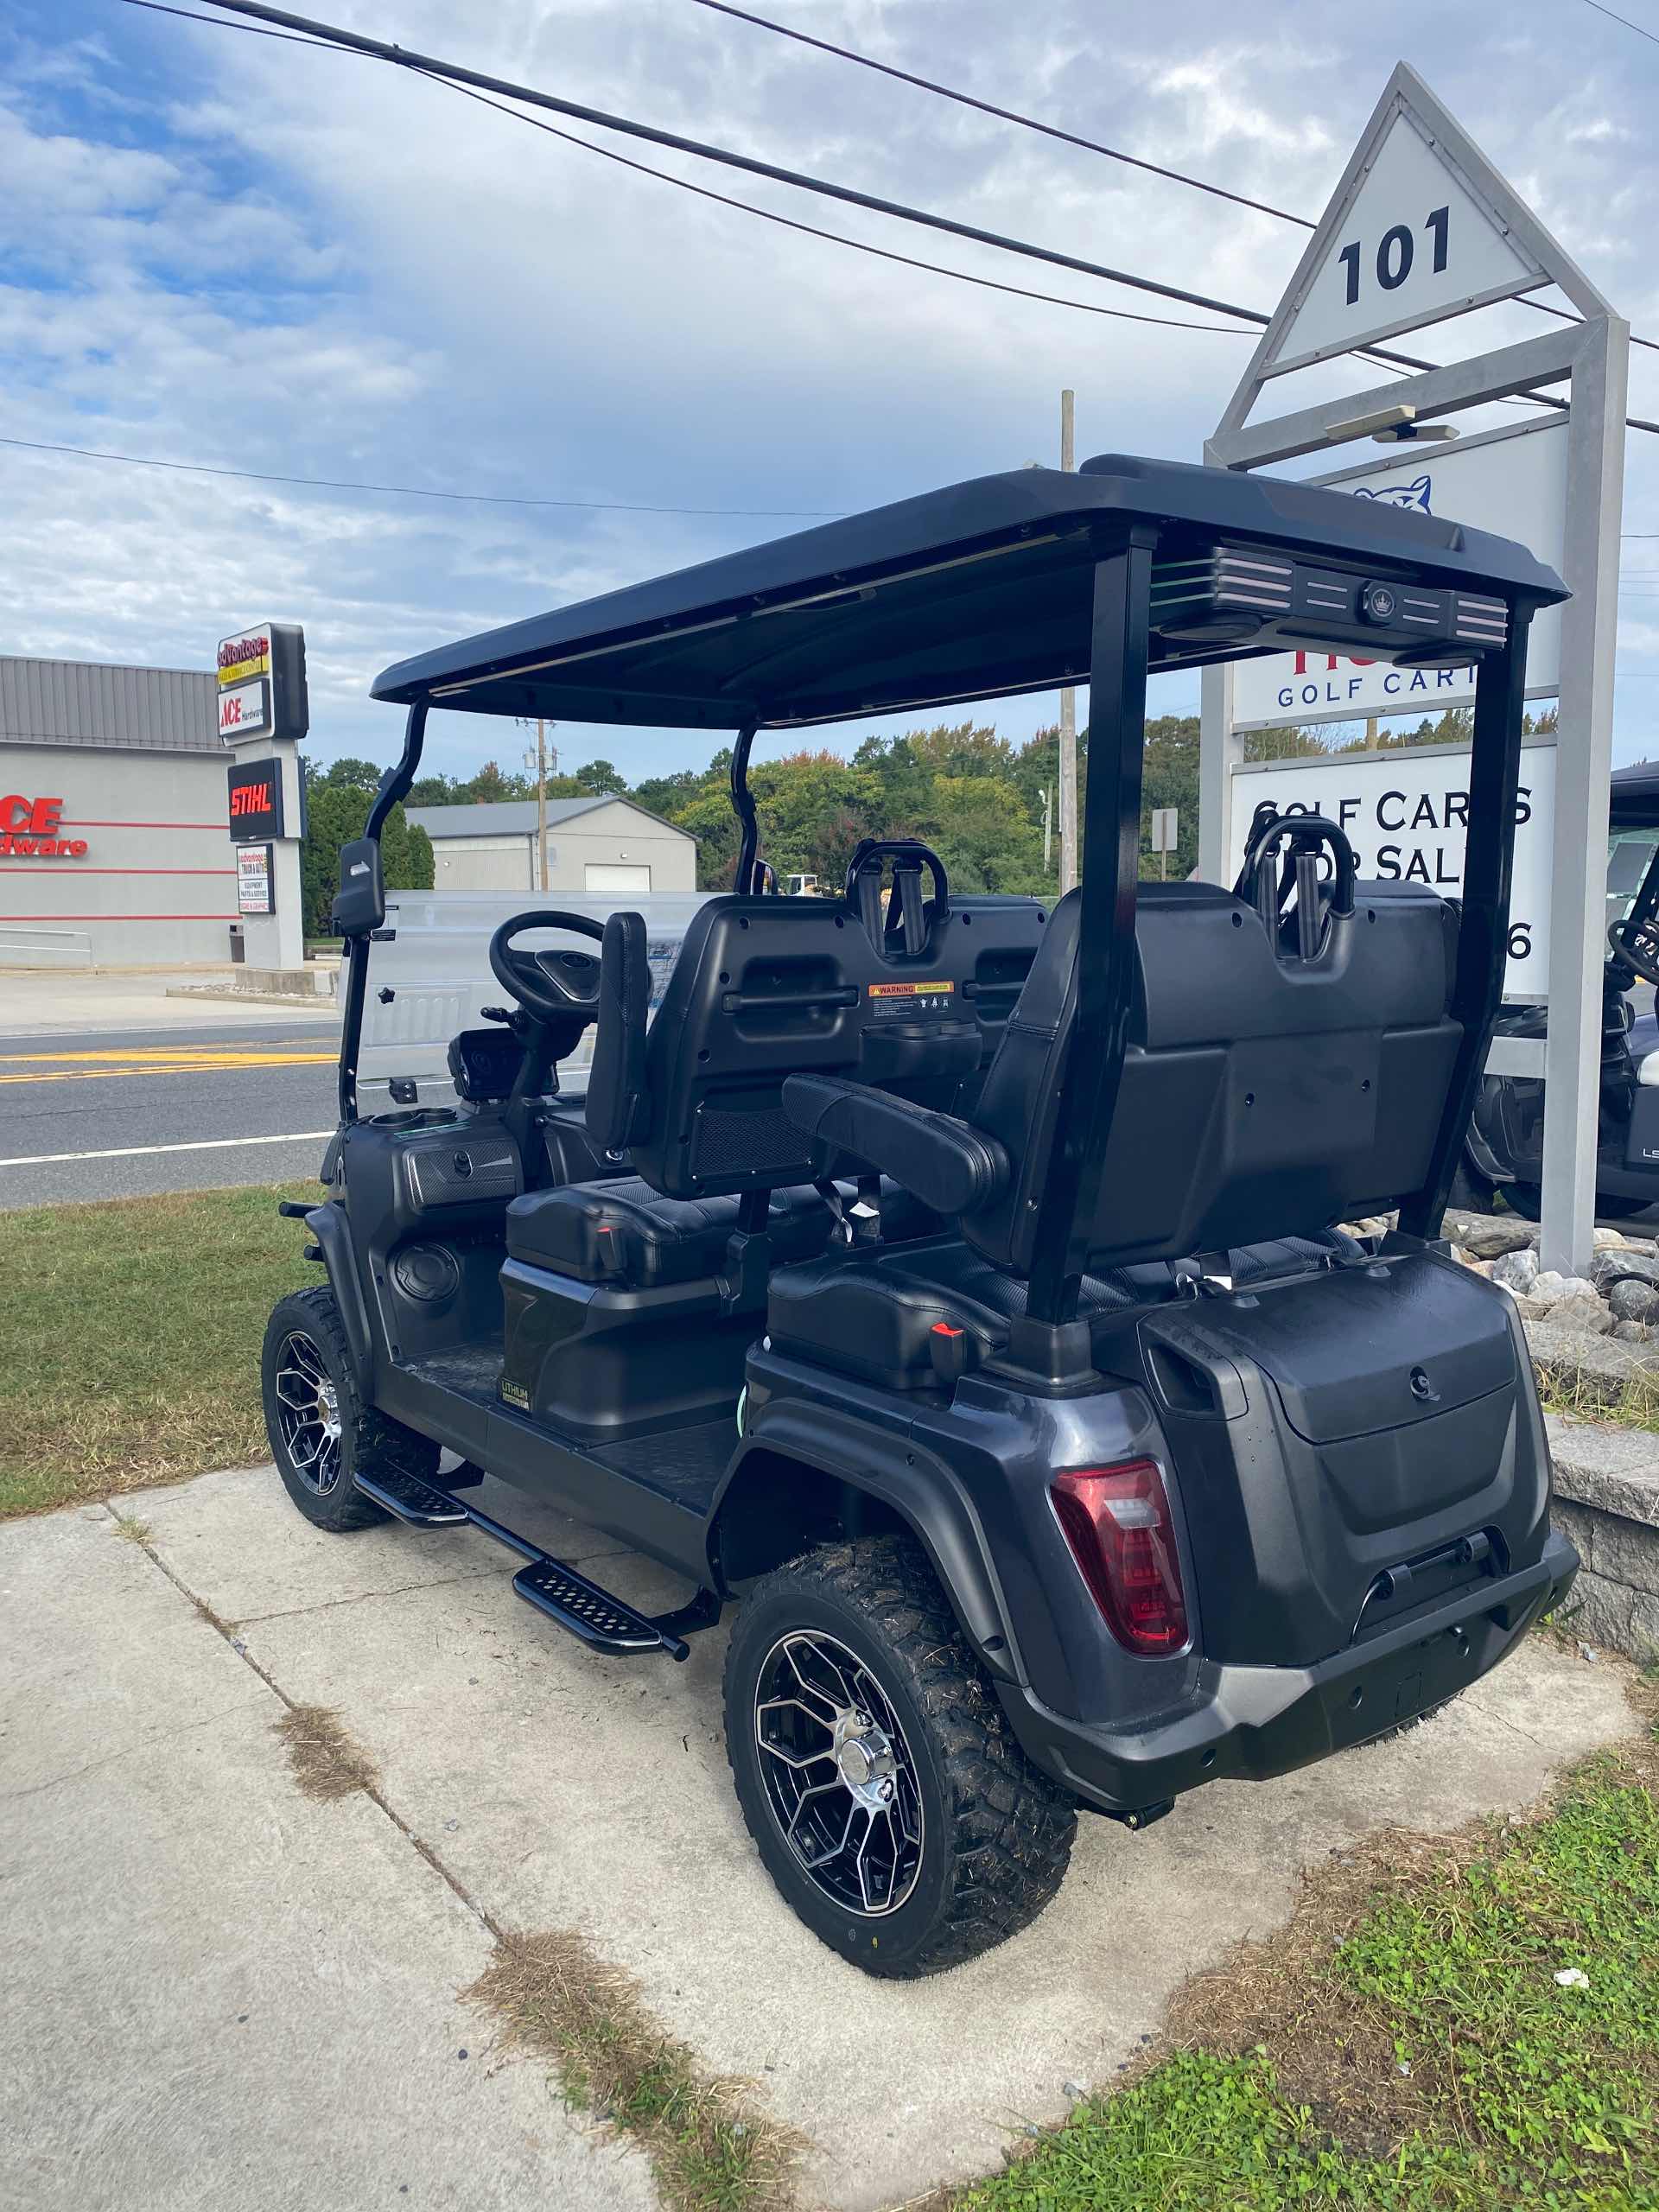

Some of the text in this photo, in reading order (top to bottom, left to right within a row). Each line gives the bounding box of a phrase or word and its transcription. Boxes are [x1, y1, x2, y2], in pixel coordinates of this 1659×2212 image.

[1338, 206, 1449, 306] 101
[1278, 677, 1363, 707] GOLF
[221, 697, 264, 728] ACE Hardware
[231, 783, 271, 816] STIHL
[1376, 786, 1533, 831] CARS
[1376, 845, 1467, 883] SAL
[880, 985, 913, 994] WARNING
